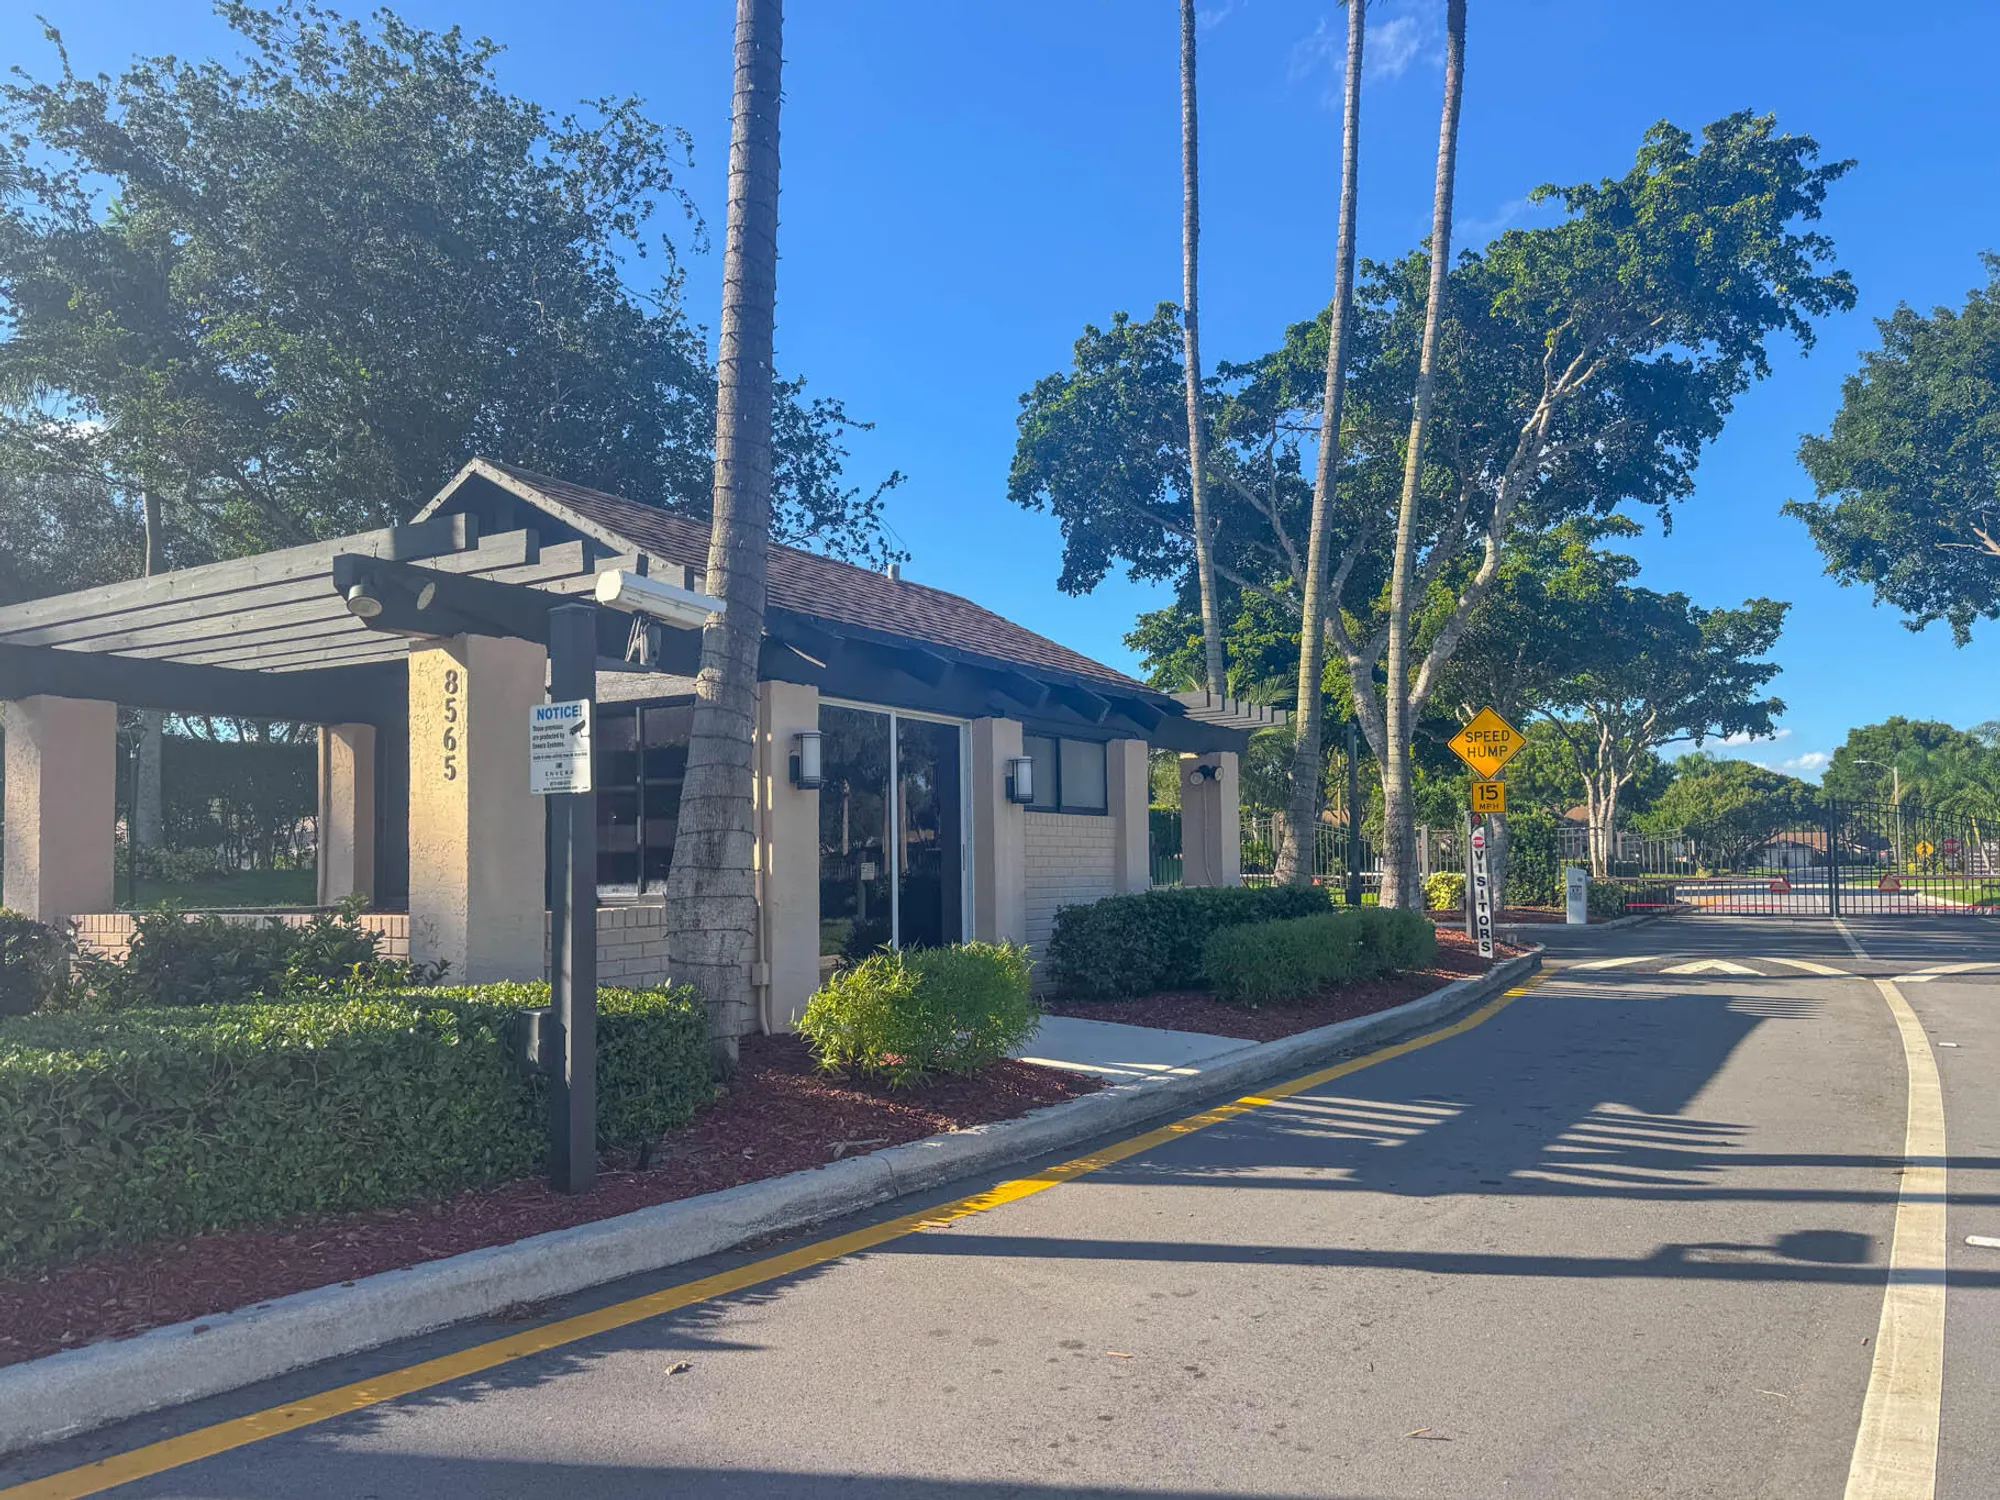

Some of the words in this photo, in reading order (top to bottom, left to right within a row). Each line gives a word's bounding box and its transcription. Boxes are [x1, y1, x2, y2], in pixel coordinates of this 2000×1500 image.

[537, 704, 582, 720] NOTICE!
[443, 669, 459, 781] 8565
[1465, 730, 1510, 742] SPEED
[1467, 746, 1508, 758] HUMP
[1479, 785, 1498, 801] 15
[1474, 850, 1491, 952] VISITORS
